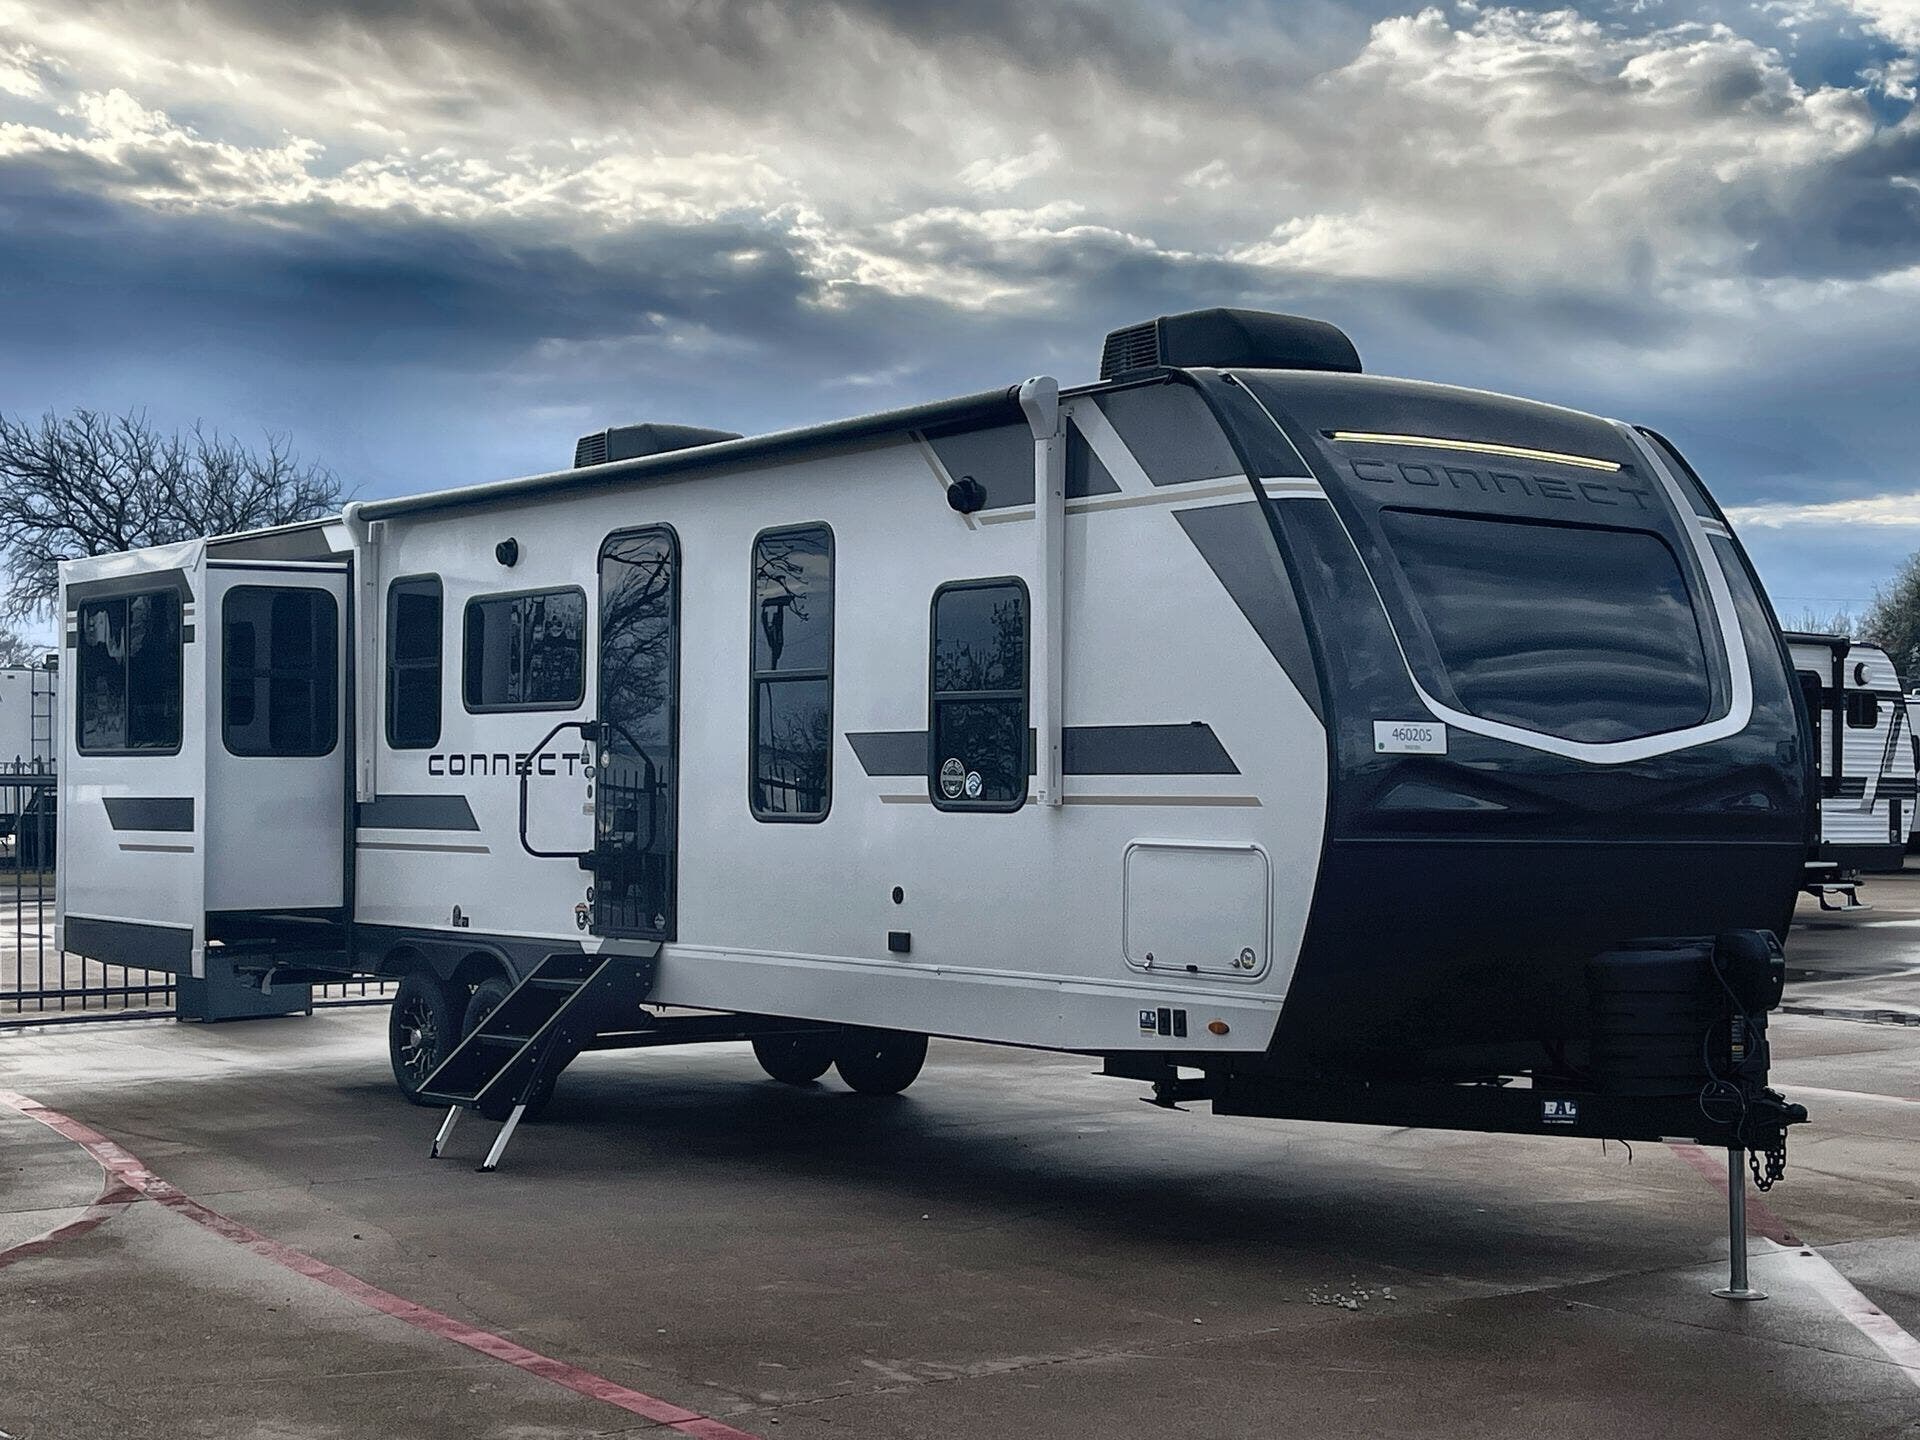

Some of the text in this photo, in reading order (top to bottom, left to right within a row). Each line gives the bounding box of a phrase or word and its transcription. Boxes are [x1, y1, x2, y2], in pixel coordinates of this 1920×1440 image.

[1350, 459, 1652, 510] CONNECT
[1391, 727, 1433, 742] 460205
[428, 753, 581, 776] CONNECT
